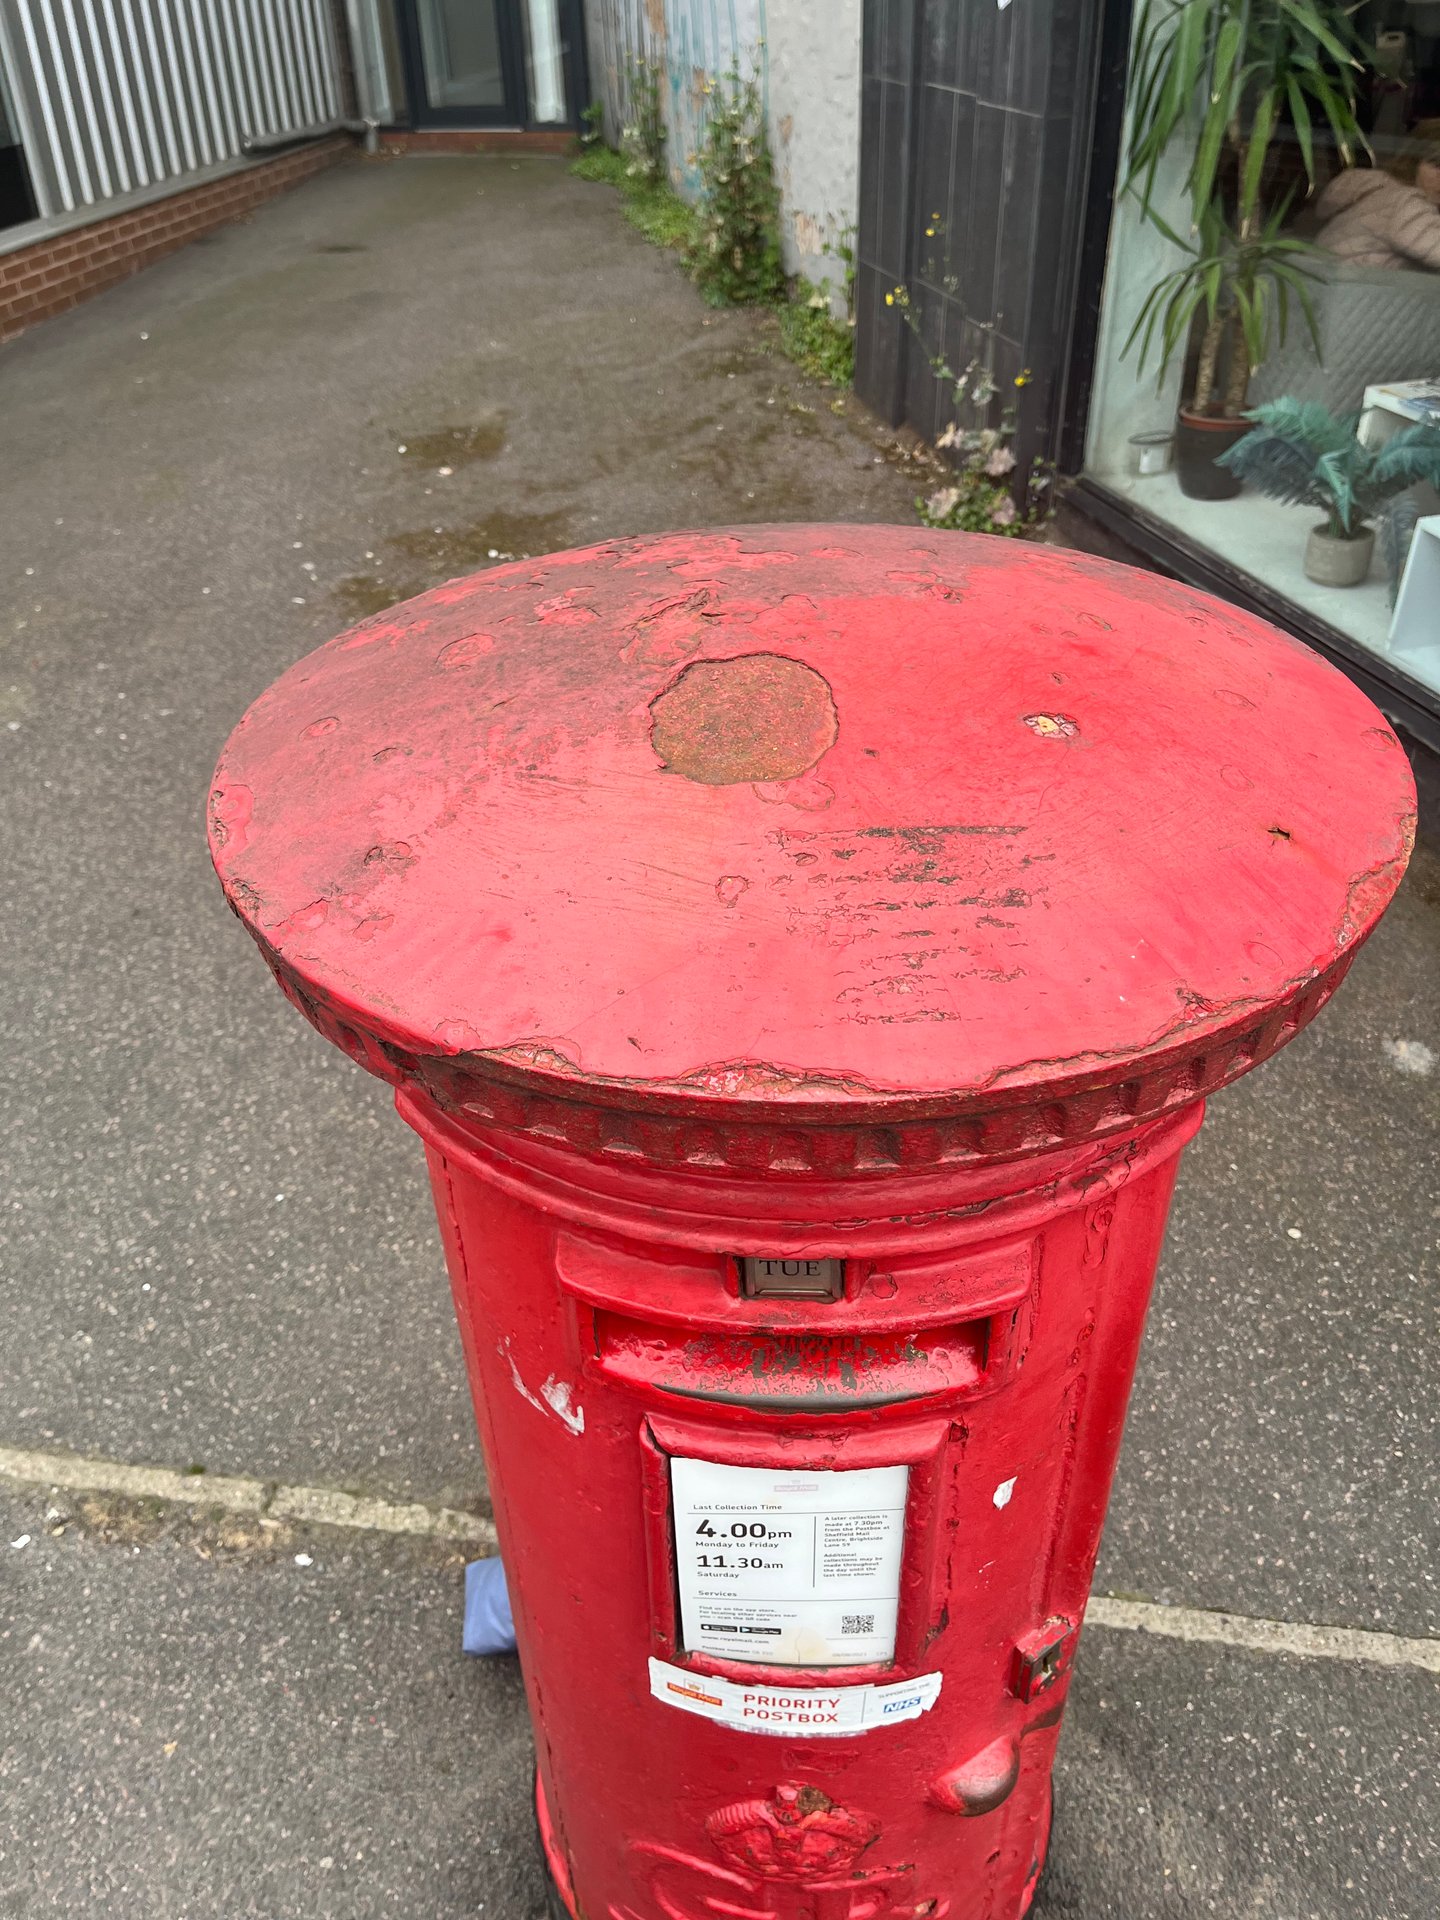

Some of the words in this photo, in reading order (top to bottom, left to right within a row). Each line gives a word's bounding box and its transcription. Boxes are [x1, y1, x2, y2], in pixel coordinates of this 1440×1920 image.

[759, 1260, 821, 1277] TUE
[696, 1519, 793, 1540] 4.00pm
[695, 1541, 733, 1549] Monday
[697, 1555, 784, 1569] 11.30am
[743, 1693, 841, 1709] PRIORITY
[885, 1697, 921, 1713] NHS
[743, 1708, 839, 1723] POSTBOX
